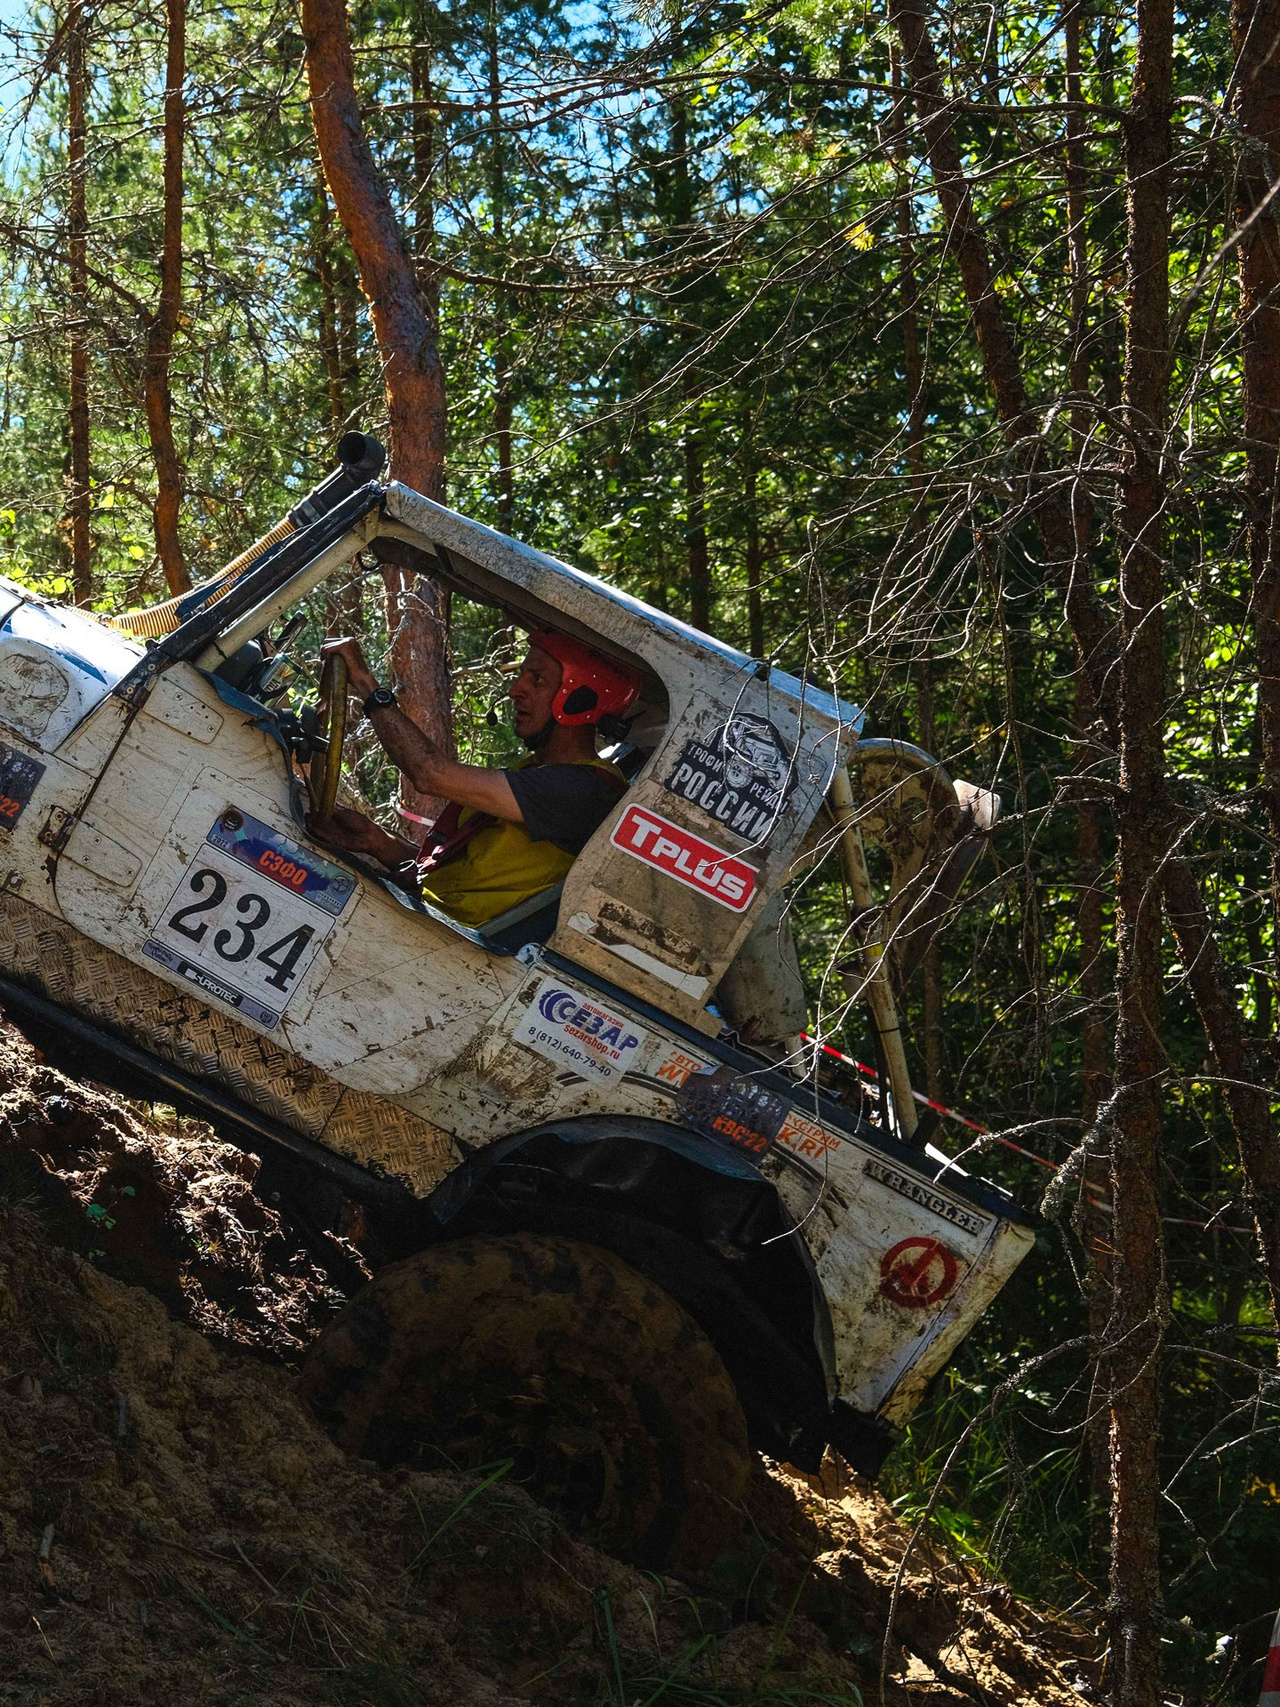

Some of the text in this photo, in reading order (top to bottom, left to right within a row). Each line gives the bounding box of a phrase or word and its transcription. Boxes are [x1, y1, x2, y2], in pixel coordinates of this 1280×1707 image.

[670, 762, 777, 843] РОССИИ
[212, 834, 229, 848] 2022
[631, 813, 727, 901] TPLUS
[259, 850, 308, 886] СЗФО
[167, 868, 316, 994] 234
[192, 971, 239, 1005] SUPROTEC
[557, 1000, 639, 1052] СЕЗАР
[582, 1002, 625, 1029] автомагазин
[528, 1026, 612, 1077] 8 (812) 640-79-40
[563, 1023, 621, 1060] sezarshop.ru
[867, 1164, 987, 1235] WRANGLER
